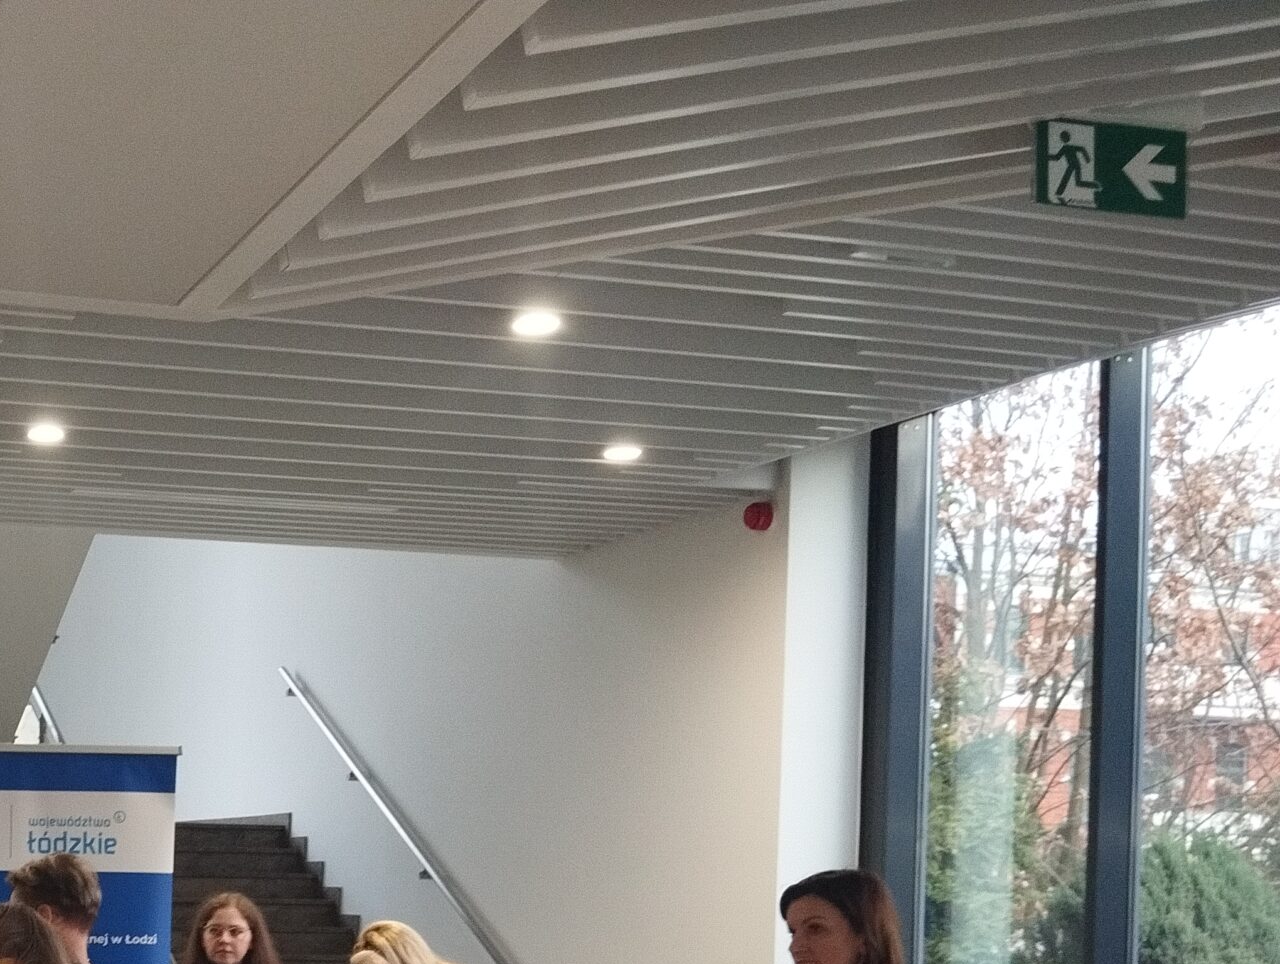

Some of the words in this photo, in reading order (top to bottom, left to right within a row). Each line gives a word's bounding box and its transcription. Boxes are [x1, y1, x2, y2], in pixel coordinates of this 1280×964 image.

[28, 814, 111, 829] województwo
[27, 830, 118, 855] łódzkie
[111, 935, 123, 945] w
[125, 933, 158, 945] Łodzi
